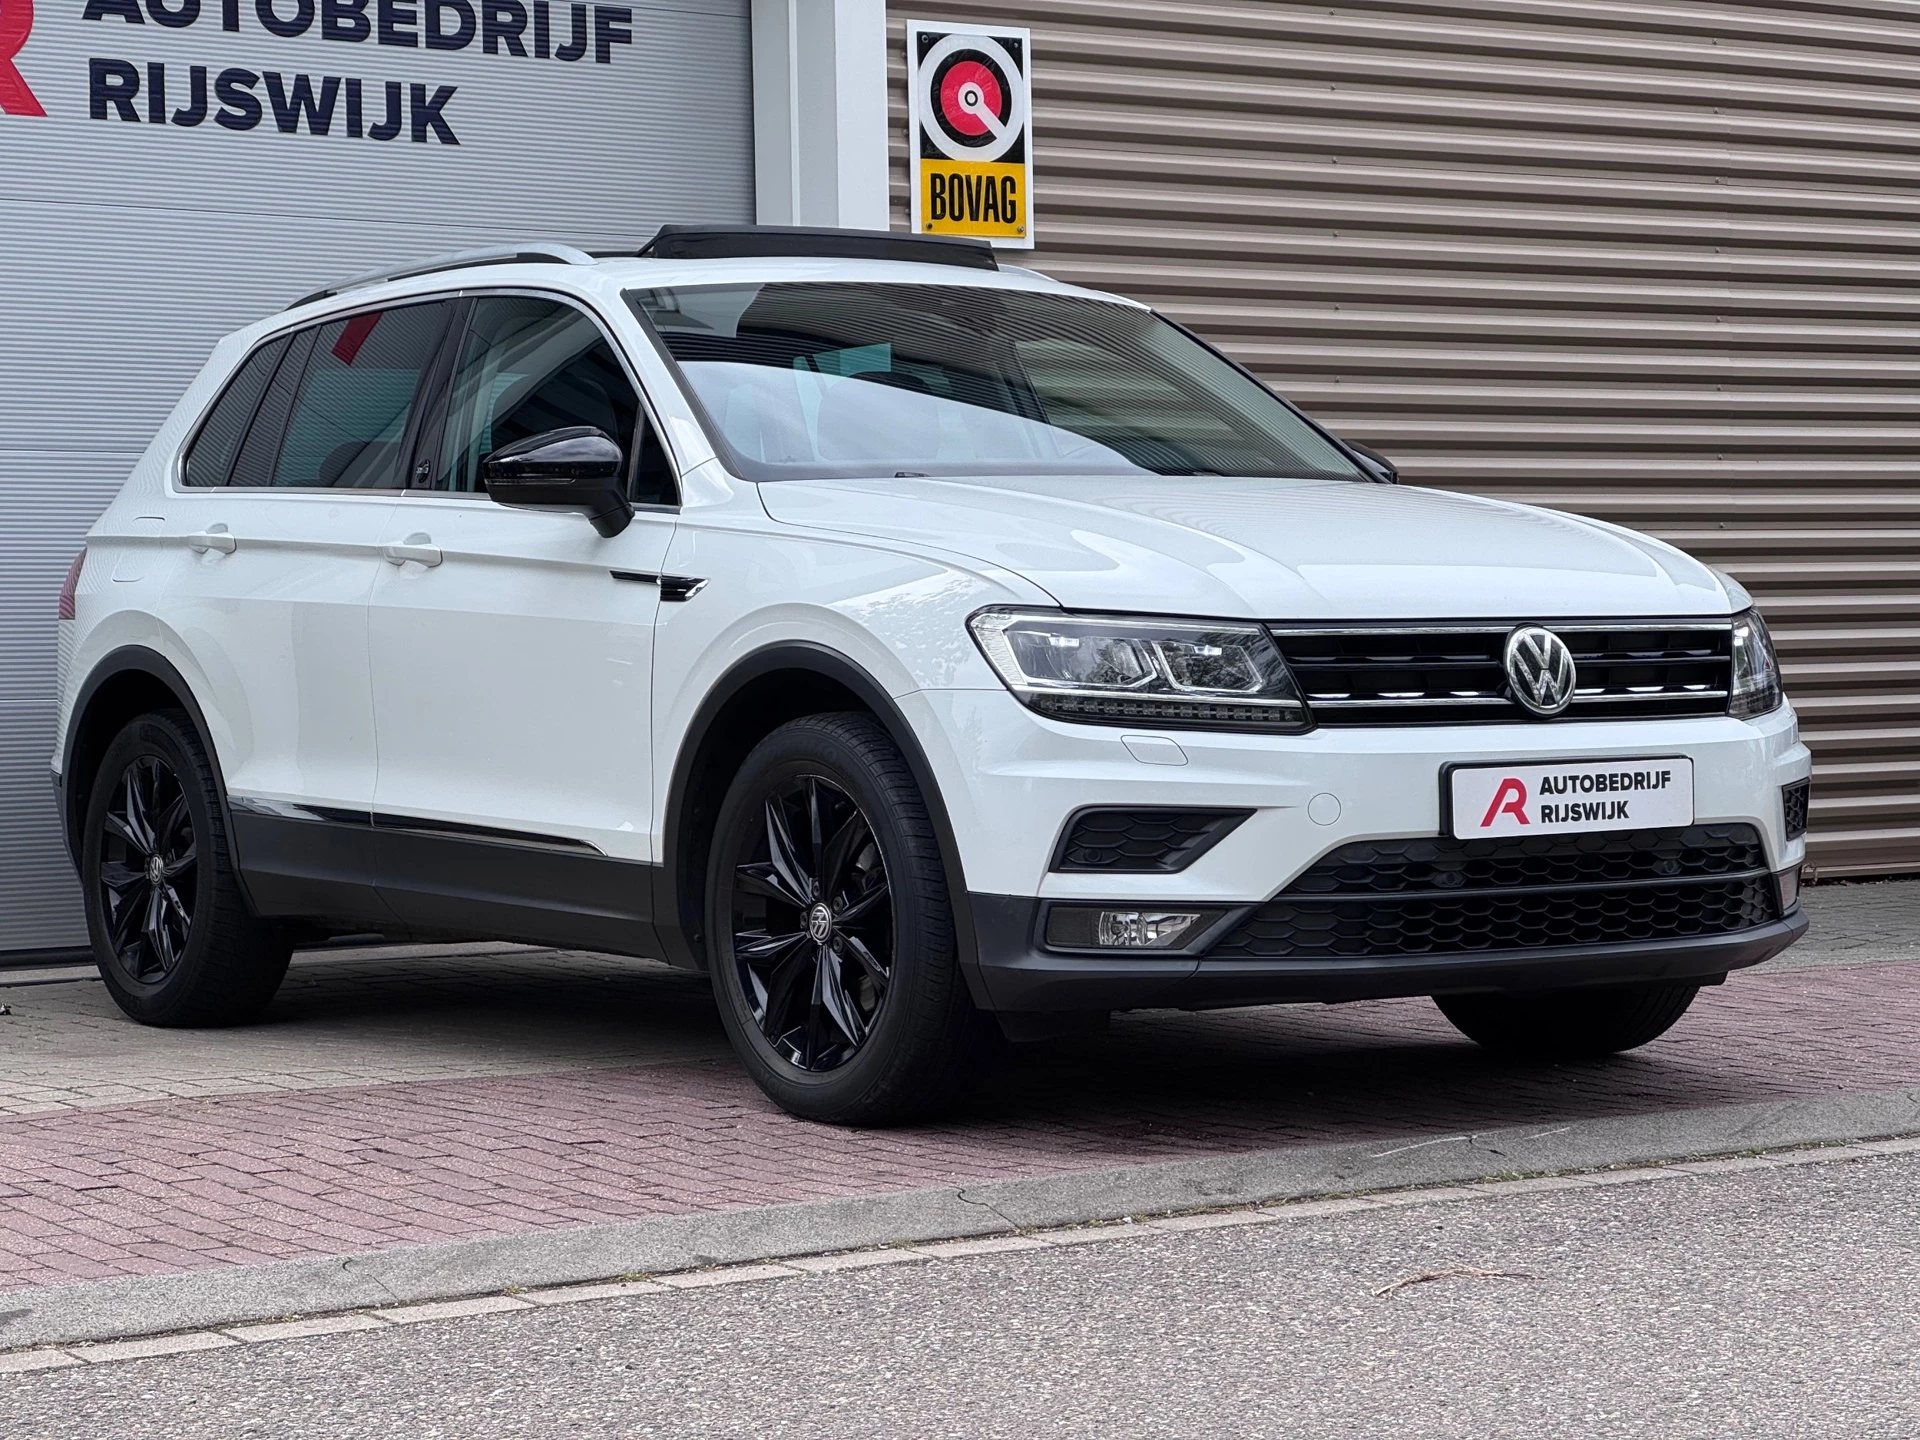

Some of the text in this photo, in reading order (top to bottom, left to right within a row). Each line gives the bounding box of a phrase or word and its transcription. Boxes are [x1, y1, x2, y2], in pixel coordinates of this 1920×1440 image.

[89, 57, 460, 146] RIJSWIJK
[930, 172, 1017, 224] BOVAG
[1539, 771, 1671, 795] AUTOBEDRIJF
[1540, 801, 1629, 823] RIJSWIJK
